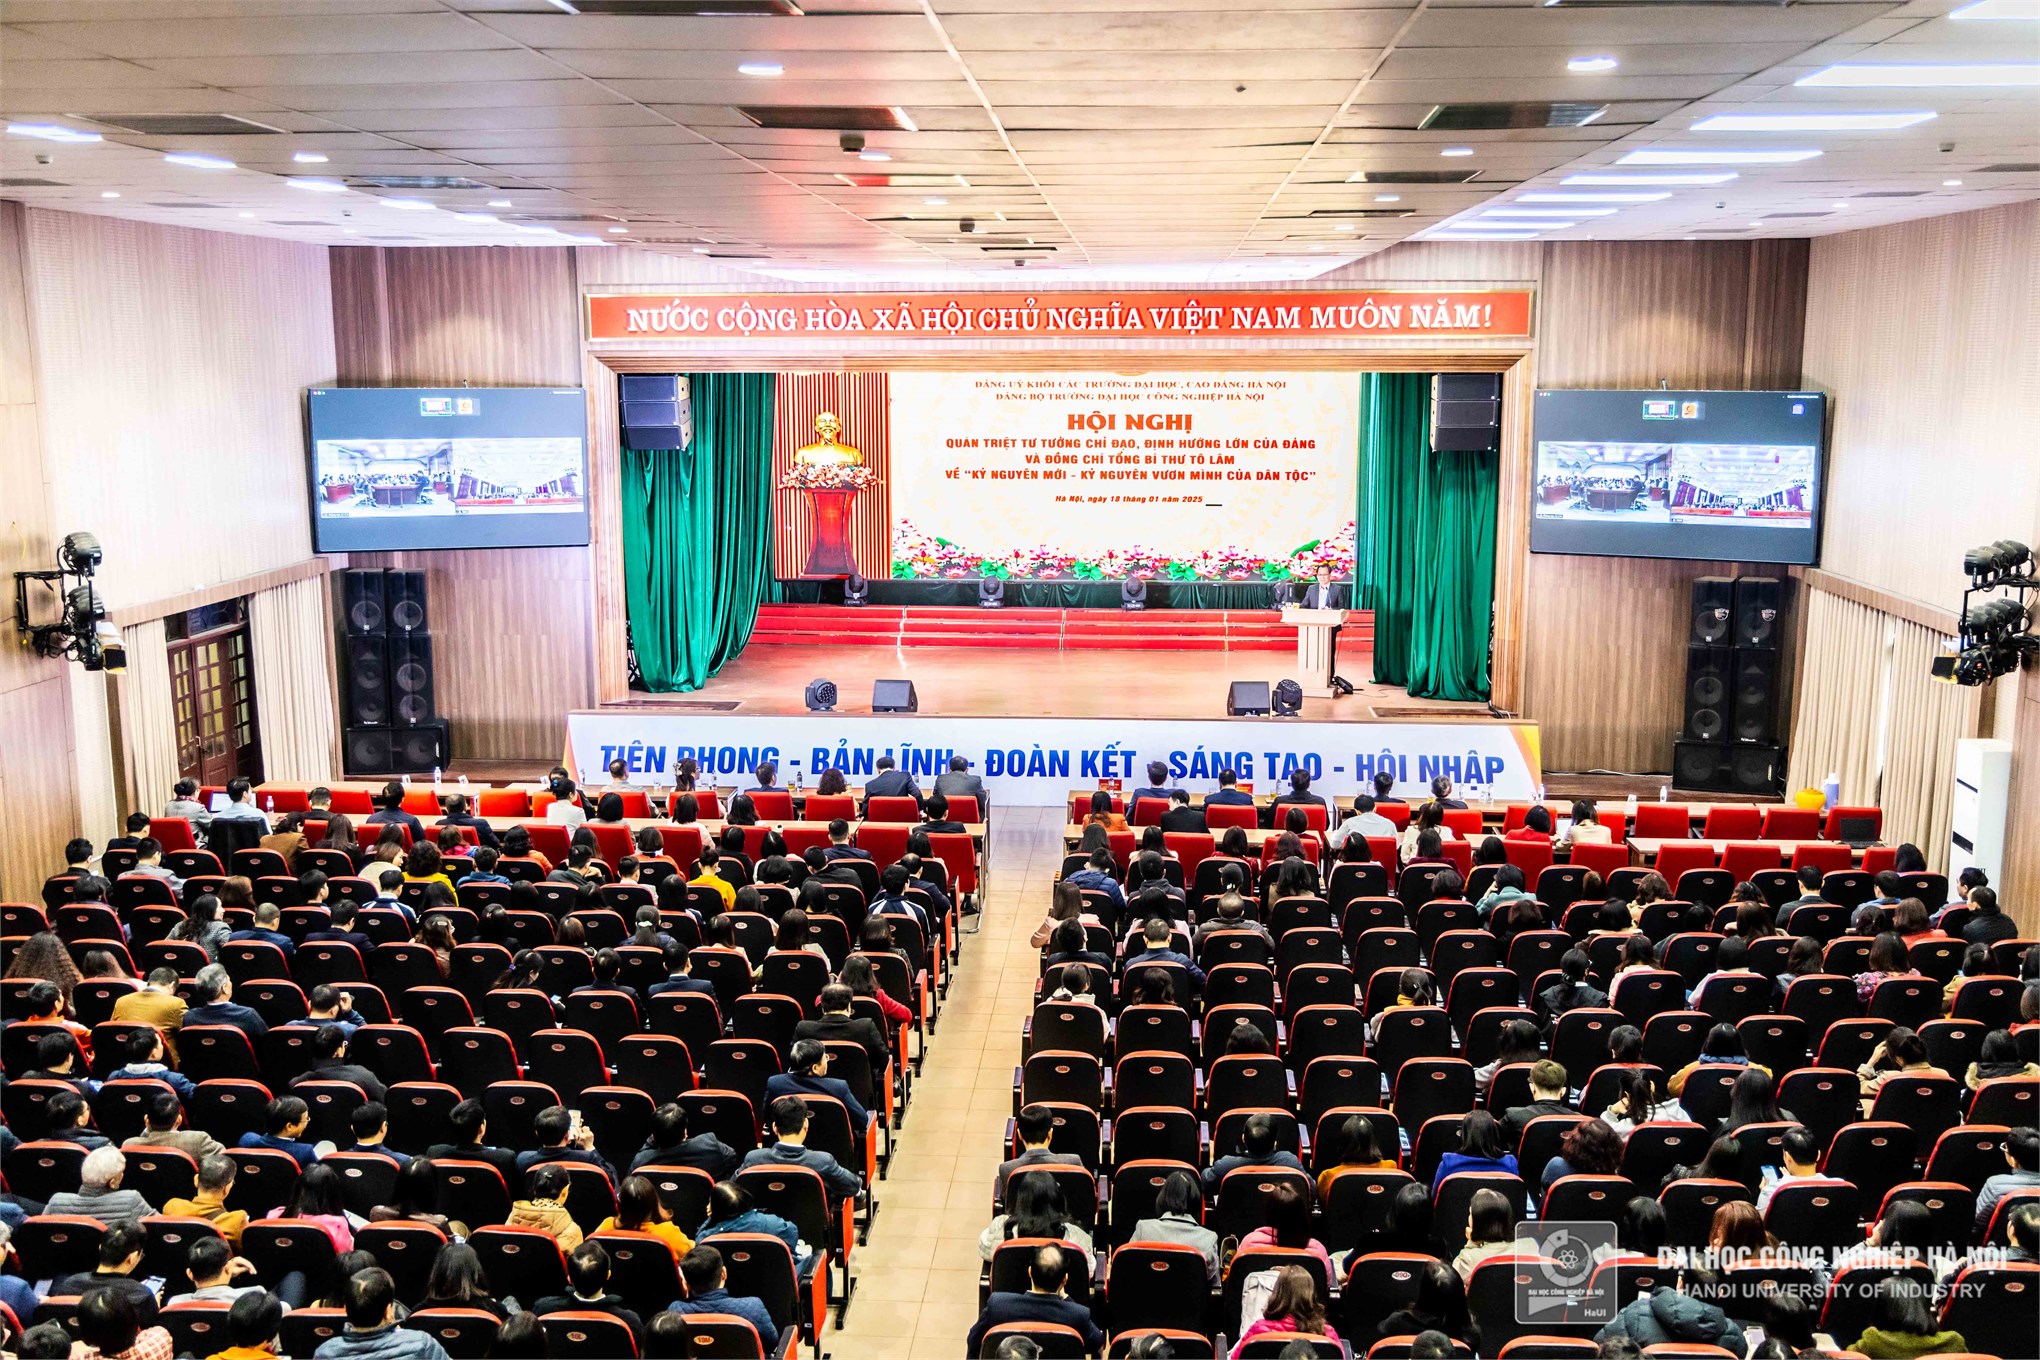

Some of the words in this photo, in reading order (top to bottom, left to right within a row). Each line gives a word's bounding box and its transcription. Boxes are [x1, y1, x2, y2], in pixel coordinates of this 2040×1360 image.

[627, 299, 709, 332] NƯỚC
[717, 302, 798, 336] CỘNG
[805, 301, 864, 331] HÒA
[872, 303, 915, 331] XÃ
[921, 302, 973, 335] HỘI
[978, 297, 1039, 331] CHỦ
[1046, 301, 1143, 330] NGHĨA
[1152, 300, 1222, 334] VIỆT
[1231, 306, 1300, 328] NAM
[1310, 299, 1400, 329] MUÔN
[1408, 299, 1492, 329] NĂM!
[1067, 411, 1116, 434] HỘI
[1125, 414, 1192, 434] NGHỊ
[984, 437, 1017, 450] TRIỆT
[1021, 438, 1037, 448] TƯ
[1041, 437, 1081, 448] TƯỞNG
[1086, 436, 1107, 448] CHỈ
[1111, 439, 1140, 450] ĐẠO,
[1144, 439, 1174, 450] ĐỊNH
[1179, 437, 1221, 448] HƯỚNG
[1226, 437, 1249, 448] LỚN
[1254, 437, 1278, 448] CỦA
[1283, 437, 1316, 449] ĐẢNG
[1025, 453, 1040, 464] VÀ
[1045, 452, 1078, 464] ĐỒNG
[1083, 453, 1104, 464] CHÍ
[1108, 451, 1140, 464] TỔNG
[1145, 453, 1157, 464] BÍ
[1162, 454, 1186, 464] THƯ
[1190, 453, 1205, 464] TÔ
[1209, 453, 1235, 464] LÂM
[991, 468, 1038, 479] NGUYÊN
[1043, 468, 1067, 479] MỚI
[1100, 468, 1148, 480] NGUYÊN
[1152, 470, 1185, 480] VƯƠN
[1190, 469, 1223, 480] MÌNH
[1227, 468, 1251, 480] CỦA
[1256, 470, 1280, 480] DÂN
[1069, 495, 1085, 503] Nội,
[811, 738, 874, 775] BẢN
[985, 743, 1070, 777] ĐOÀN
[1081, 741, 1137, 778] KẾT
[1168, 745, 1253, 780] SÁNG
[1418, 750, 1505, 790] NHẬP
